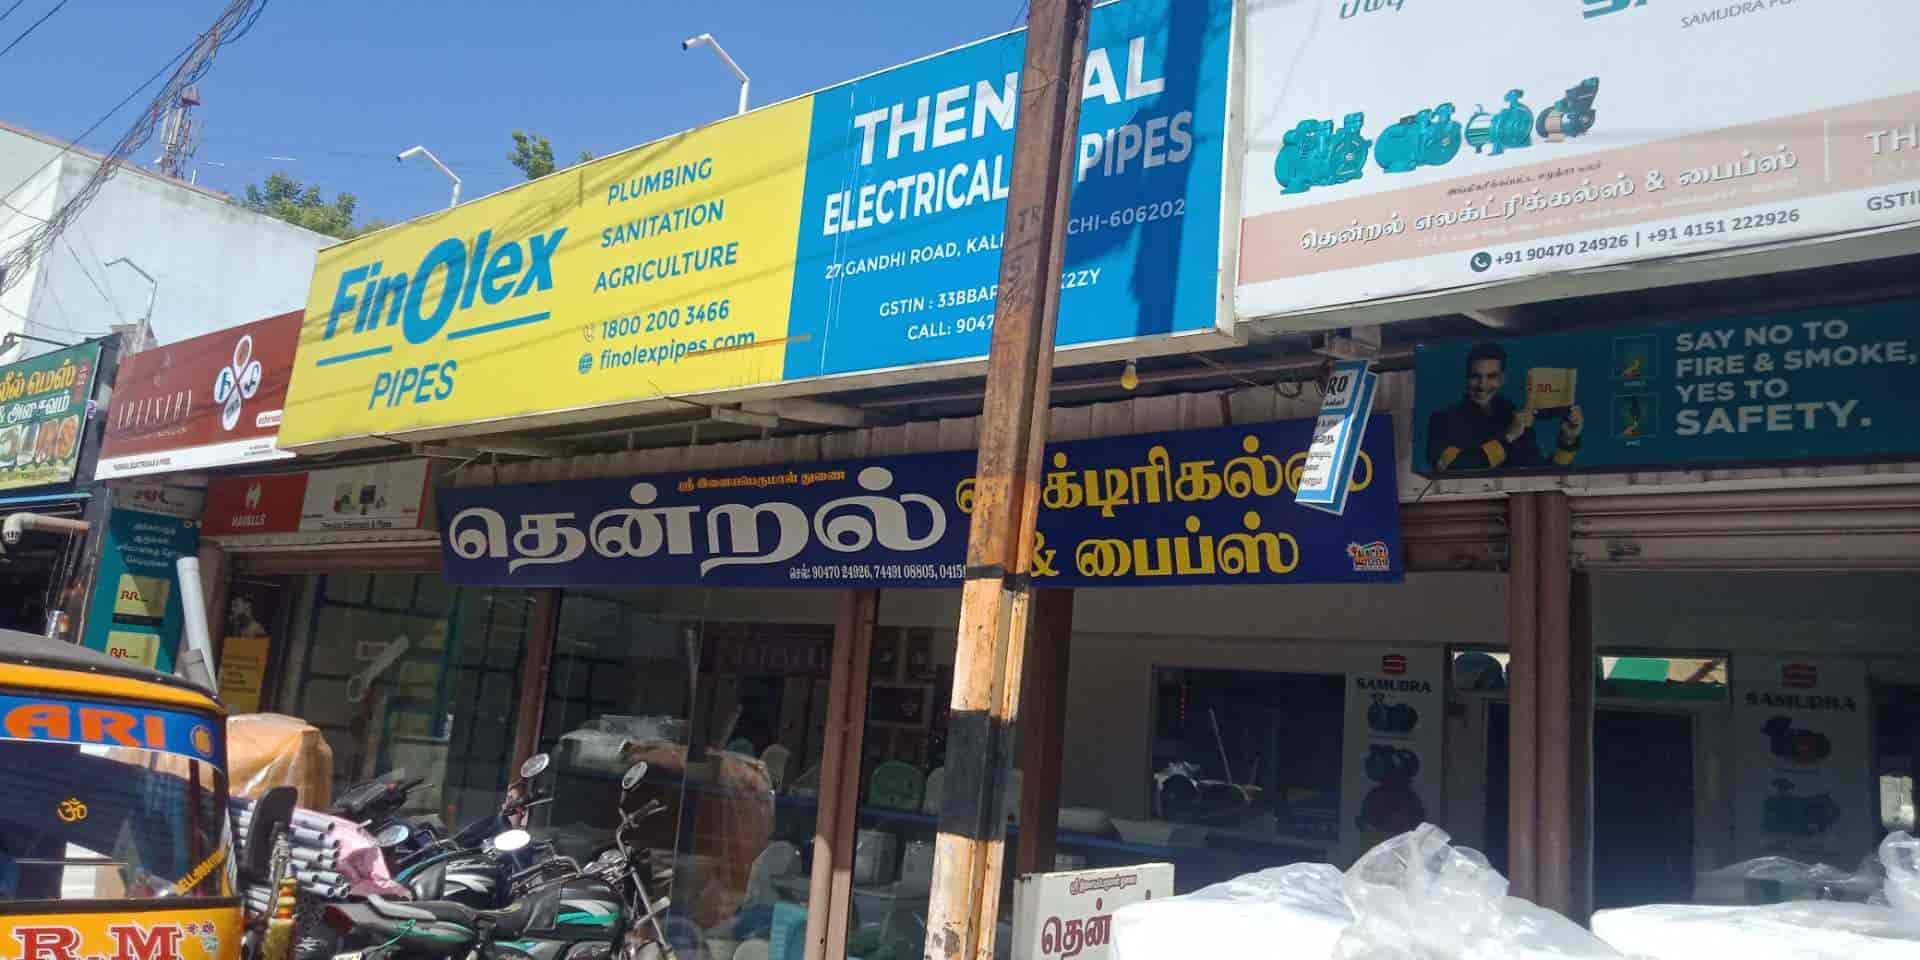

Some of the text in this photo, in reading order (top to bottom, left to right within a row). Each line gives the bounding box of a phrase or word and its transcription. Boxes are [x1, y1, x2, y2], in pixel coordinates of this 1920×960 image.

[854, 35, 1166, 166] THENAL
[1078, 111, 1193, 182] PIPES
[607, 157, 713, 206] PLUMBING
[1300, 210, 1406, 252] தென்றல்
[1647, 168, 1665, 193] &
[1679, 144, 1800, 187] பைப்ஸ்
[1867, 188, 1920, 212] GSTI
[601, 199, 725, 249] SANITATION
[1495, 249, 1523, 267] +91
[1527, 241, 1574, 262] 90470
[1579, 234, 1629, 255] 24926
[1648, 228, 1678, 244] +91
[1683, 219, 1726, 239] 4151
[1732, 208, 1801, 231] 222926
[593, 242, 739, 294] AGRICULTURE
[601, 300, 730, 341] 1800 200 3466
[879, 297, 925, 318] GSTIN
[600, 328, 756, 371] finolexpipes.com
[907, 322, 952, 341] CALL:
[1676, 319, 1849, 352] SAY NO TO
[1676, 340, 1916, 378] FIRE & SMOKE,
[368, 360, 457, 410] PIPES
[1675, 378, 1789, 404] YES TO
[1675, 399, 1873, 436] SAFETY.
[449, 466, 946, 577] தென்றல்
[1075, 510, 1300, 577] பைப்ஸ்
[812, 565, 840, 580] 90470
[874, 565, 902, 580] 74491
[1356, 676, 1432, 695] SAMUDRA
[1743, 689, 1857, 713] SAMUDRA
[1041, 896, 1113, 960] தென்
